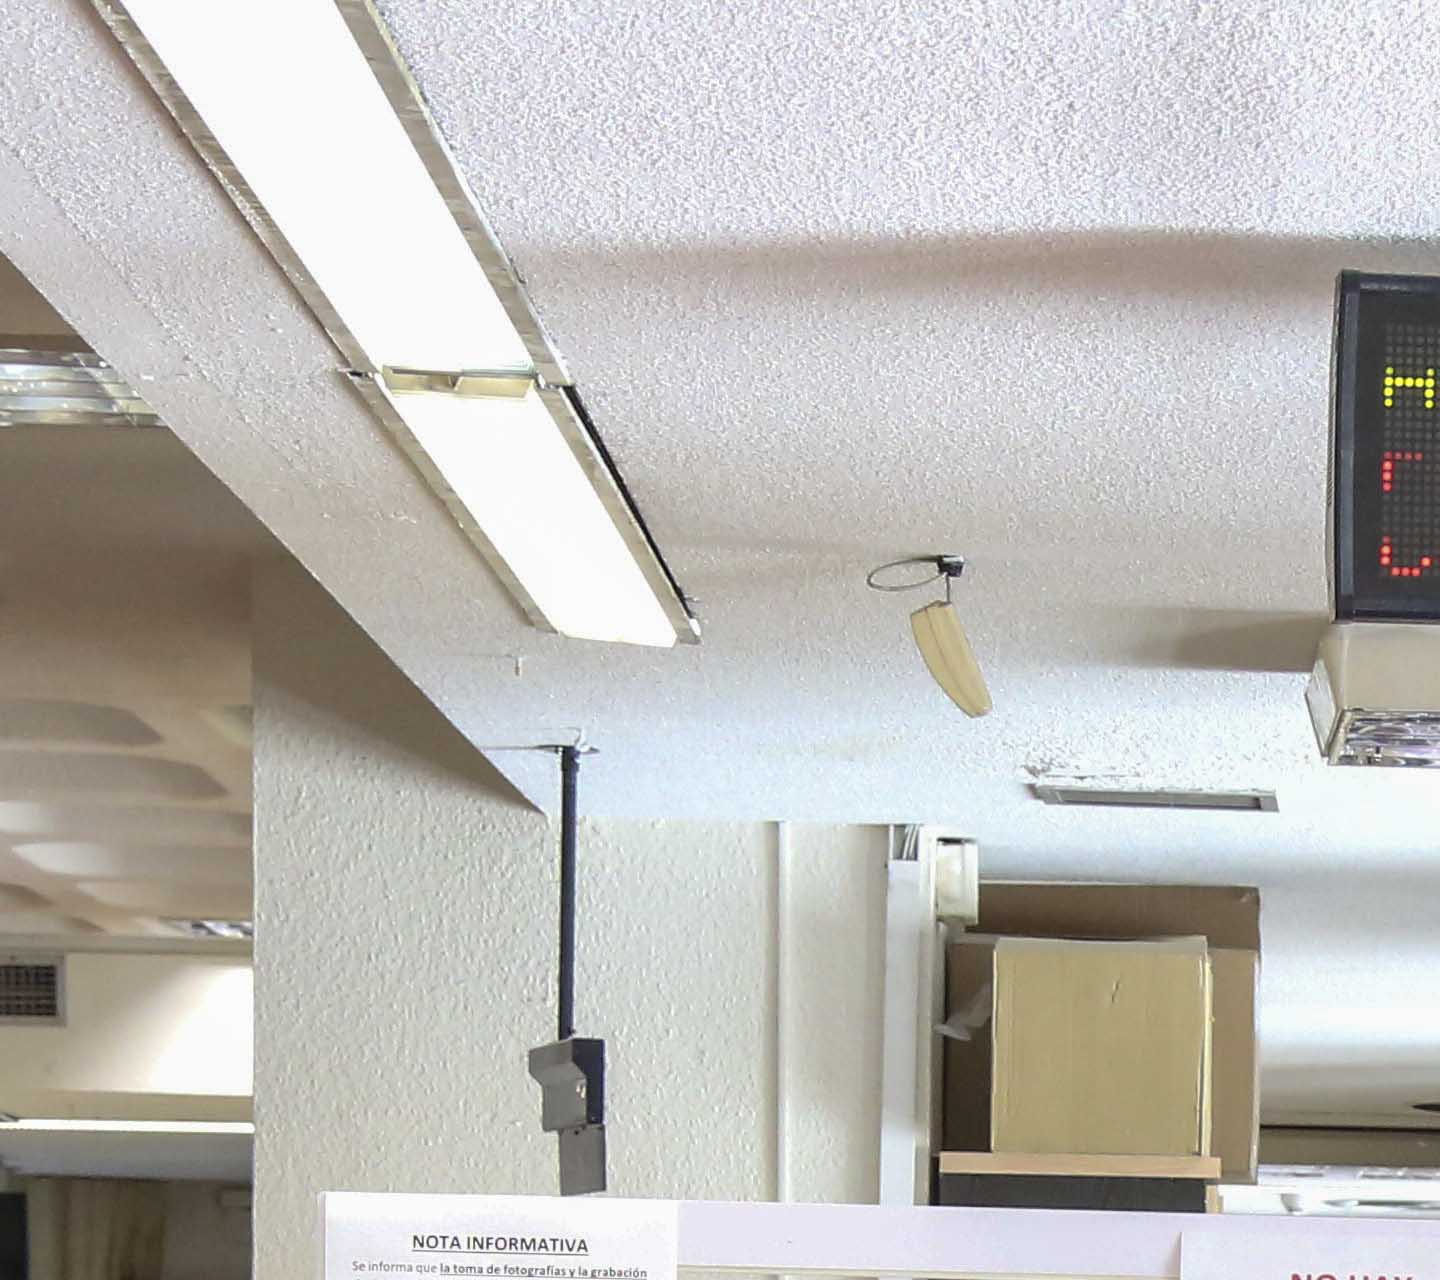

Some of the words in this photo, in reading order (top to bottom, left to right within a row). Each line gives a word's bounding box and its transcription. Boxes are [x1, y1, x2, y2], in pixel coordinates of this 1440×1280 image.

[412, 1234, 461, 1249] NOTA
[466, 1235, 588, 1253] INFORMATIVA
[351, 1260, 366, 1272] Se
[367, 1261, 413, 1273] informa
[414, 1264, 438, 1277] que
[438, 1262, 451, 1274] la
[451, 1262, 484, 1275] toma
[485, 1263, 501, 1275] de
[502, 1263, 567, 1280] fotografías
[567, 1268, 576, 1280] y
[576, 1265, 589, 1277] la
[589, 1265, 648, 1280] grabación
